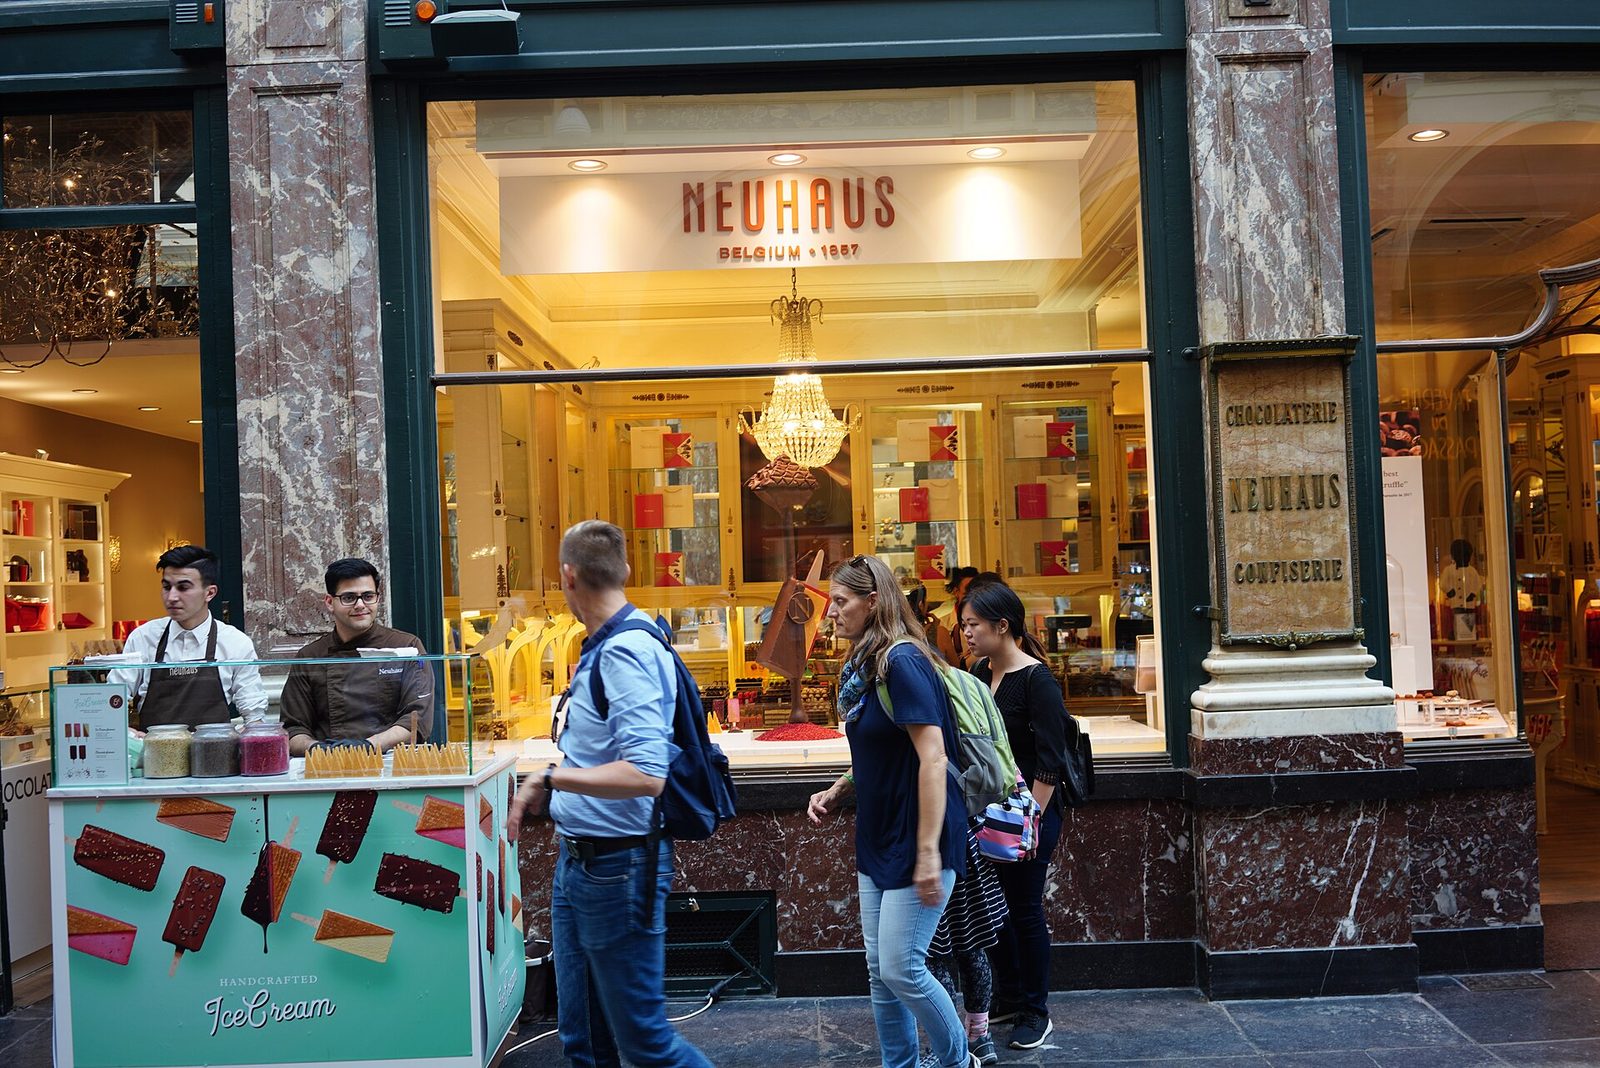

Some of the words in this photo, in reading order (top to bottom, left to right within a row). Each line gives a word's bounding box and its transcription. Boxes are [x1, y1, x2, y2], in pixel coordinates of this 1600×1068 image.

[682, 175, 896, 233] NEUHAUS
[719, 245, 801, 261] BELGIUM
[821, 244, 859, 259] 1857
[1226, 402, 1338, 427] CHOCOLATERIE
[1228, 474, 1341, 513] NEUHAUS
[1234, 559, 1343, 584] CONFISERIE
[791, 597, 810, 619] N
[219, 975, 318, 987] HANDCRAFTED
